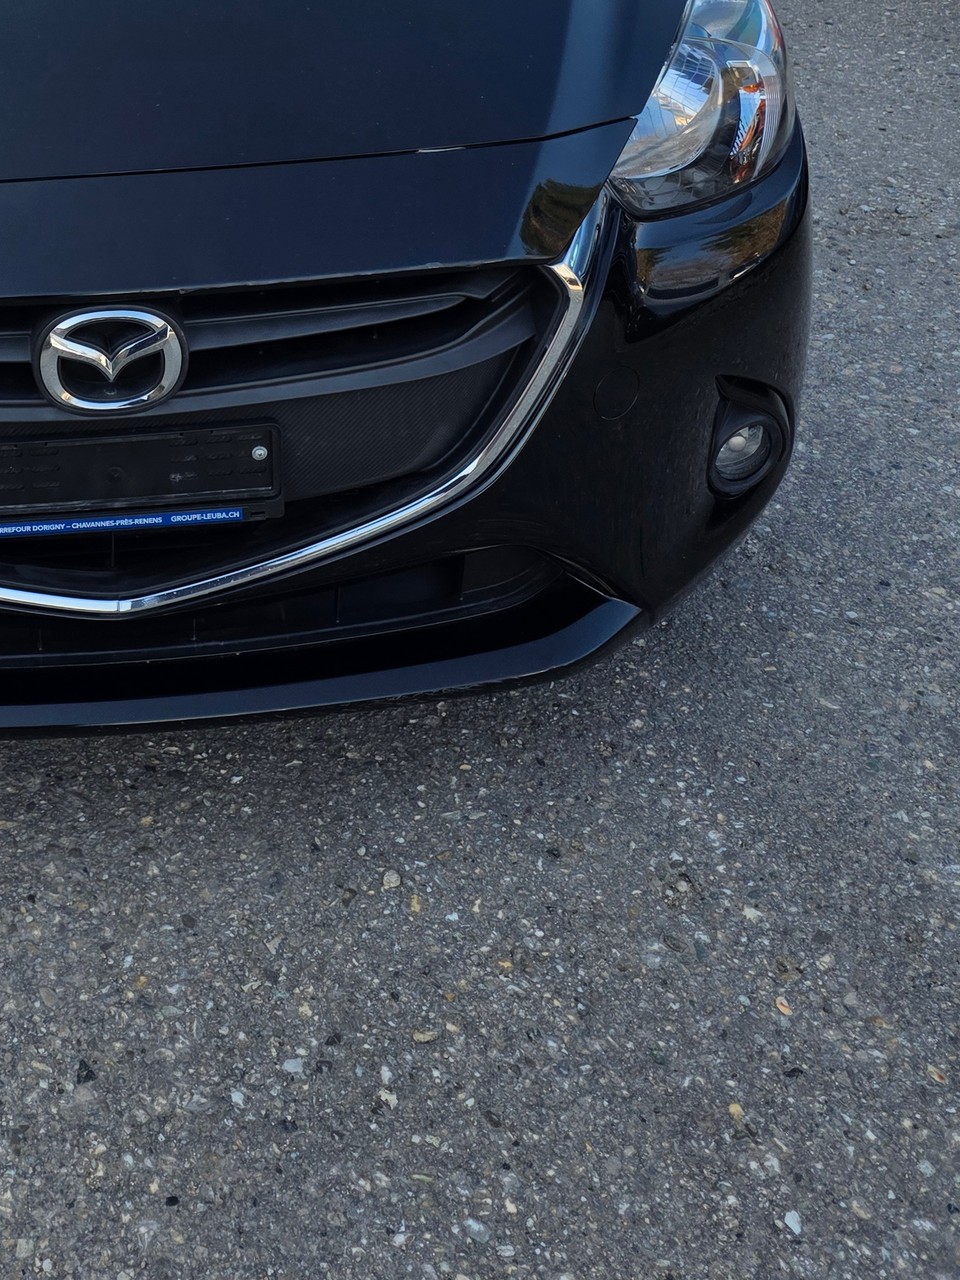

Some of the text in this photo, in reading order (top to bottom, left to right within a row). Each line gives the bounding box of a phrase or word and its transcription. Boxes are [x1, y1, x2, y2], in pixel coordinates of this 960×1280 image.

[32, 523, 65, 532] DORIGNY
[71, 516, 163, 529] CHAVANNES-PRÈS-RENENS
[170, 511, 240, 522] GROUPE-LEUBA.CH
